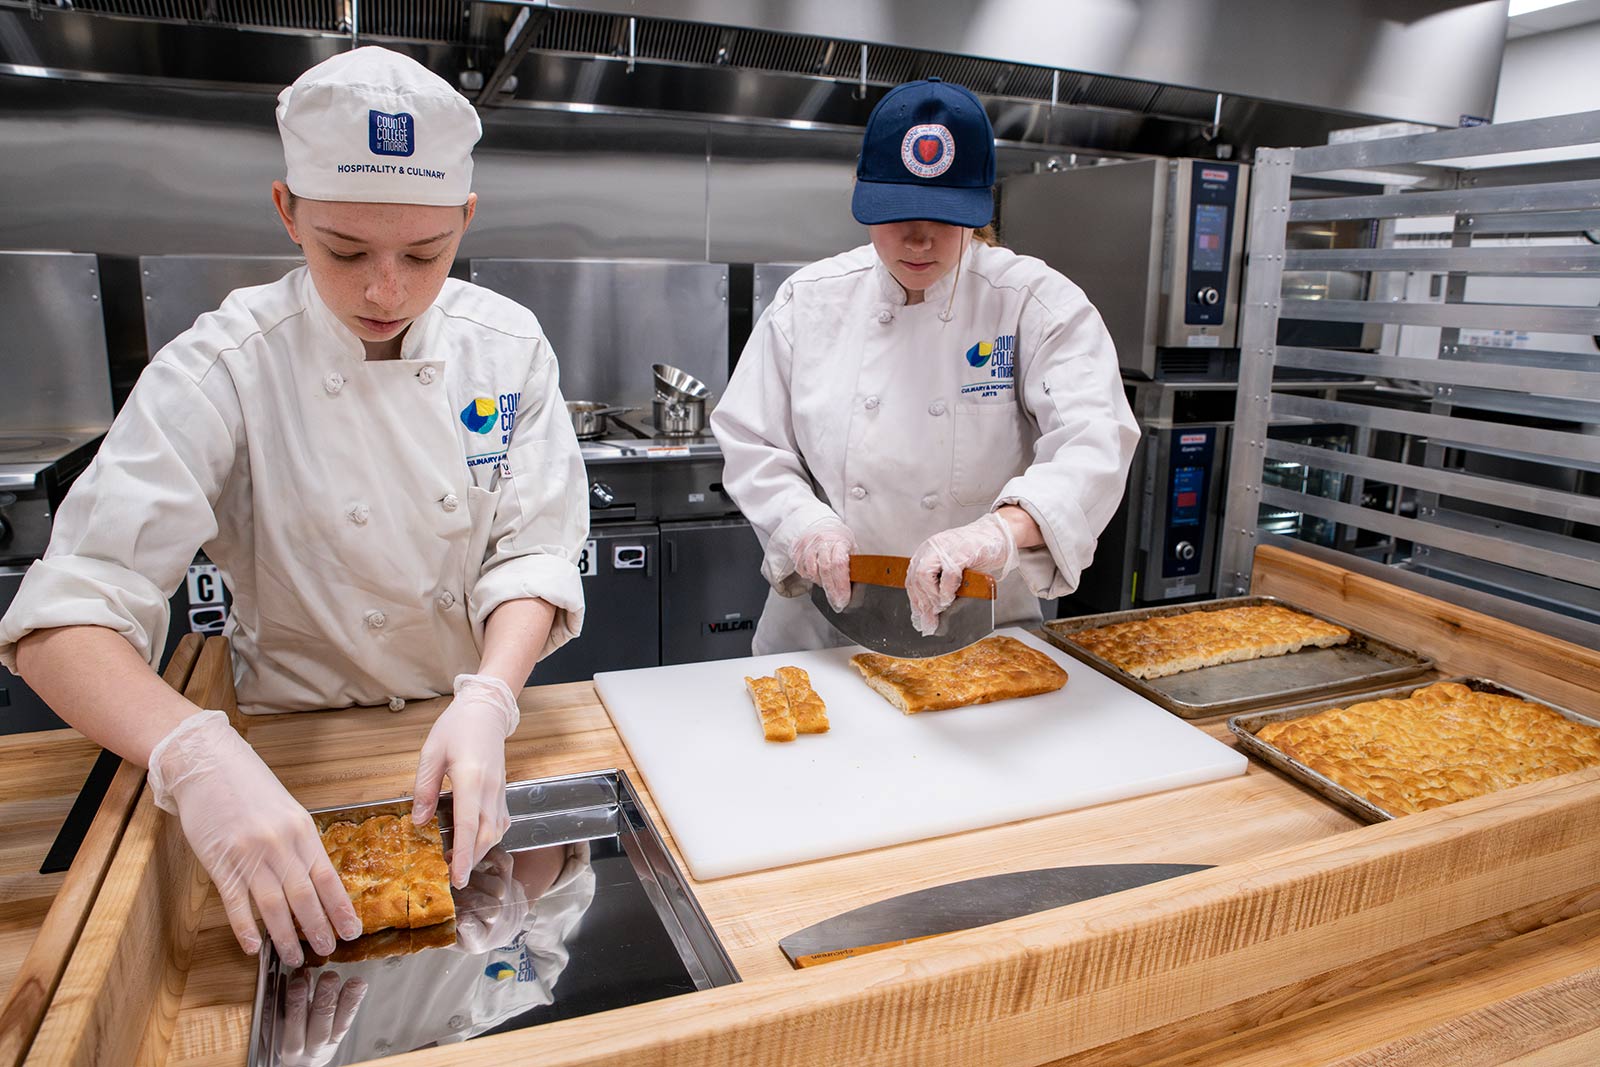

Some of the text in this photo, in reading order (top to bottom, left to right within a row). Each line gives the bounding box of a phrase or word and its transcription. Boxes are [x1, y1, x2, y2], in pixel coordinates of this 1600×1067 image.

[377, 115, 407, 130] COUNTY
[377, 128, 408, 142] COLLEGE
[383, 140, 408, 153] MORRIS
[338, 165, 446, 180] HOSPITALITY & CULINARY
[961, 385, 985, 393] CULINARY
[197, 574, 214, 602] C
[709, 620, 753, 633] VULCAN
